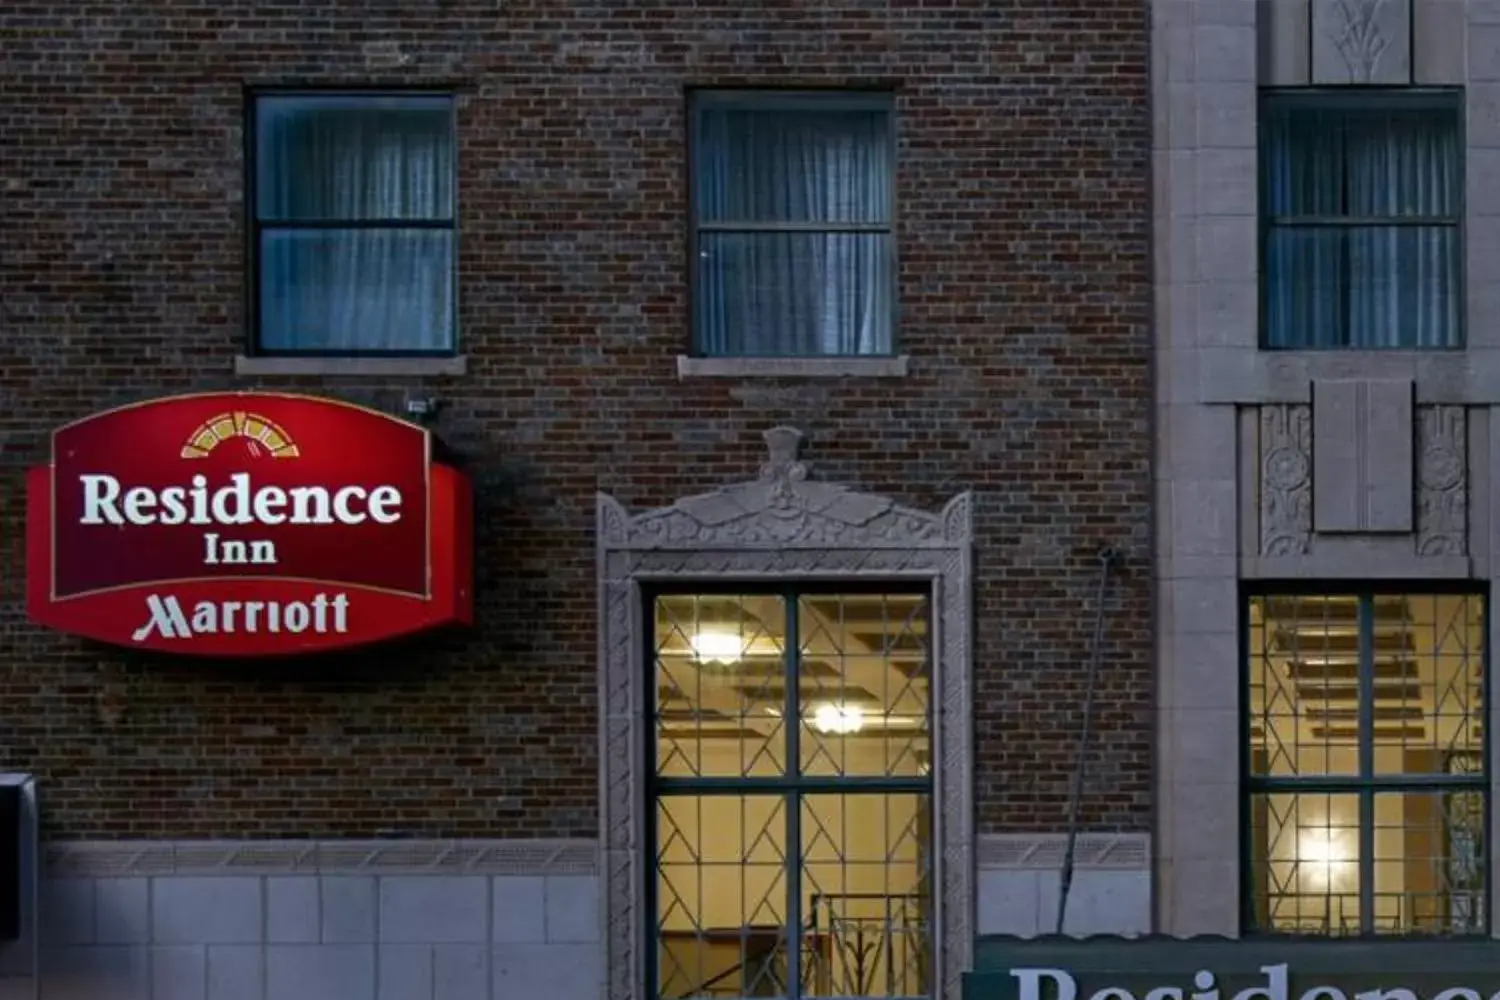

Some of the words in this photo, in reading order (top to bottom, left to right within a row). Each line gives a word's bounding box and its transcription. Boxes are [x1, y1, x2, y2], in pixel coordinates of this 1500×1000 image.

[79, 473, 402, 525] Residence
[204, 533, 277, 564] Inn
[132, 593, 349, 641] Marriott
